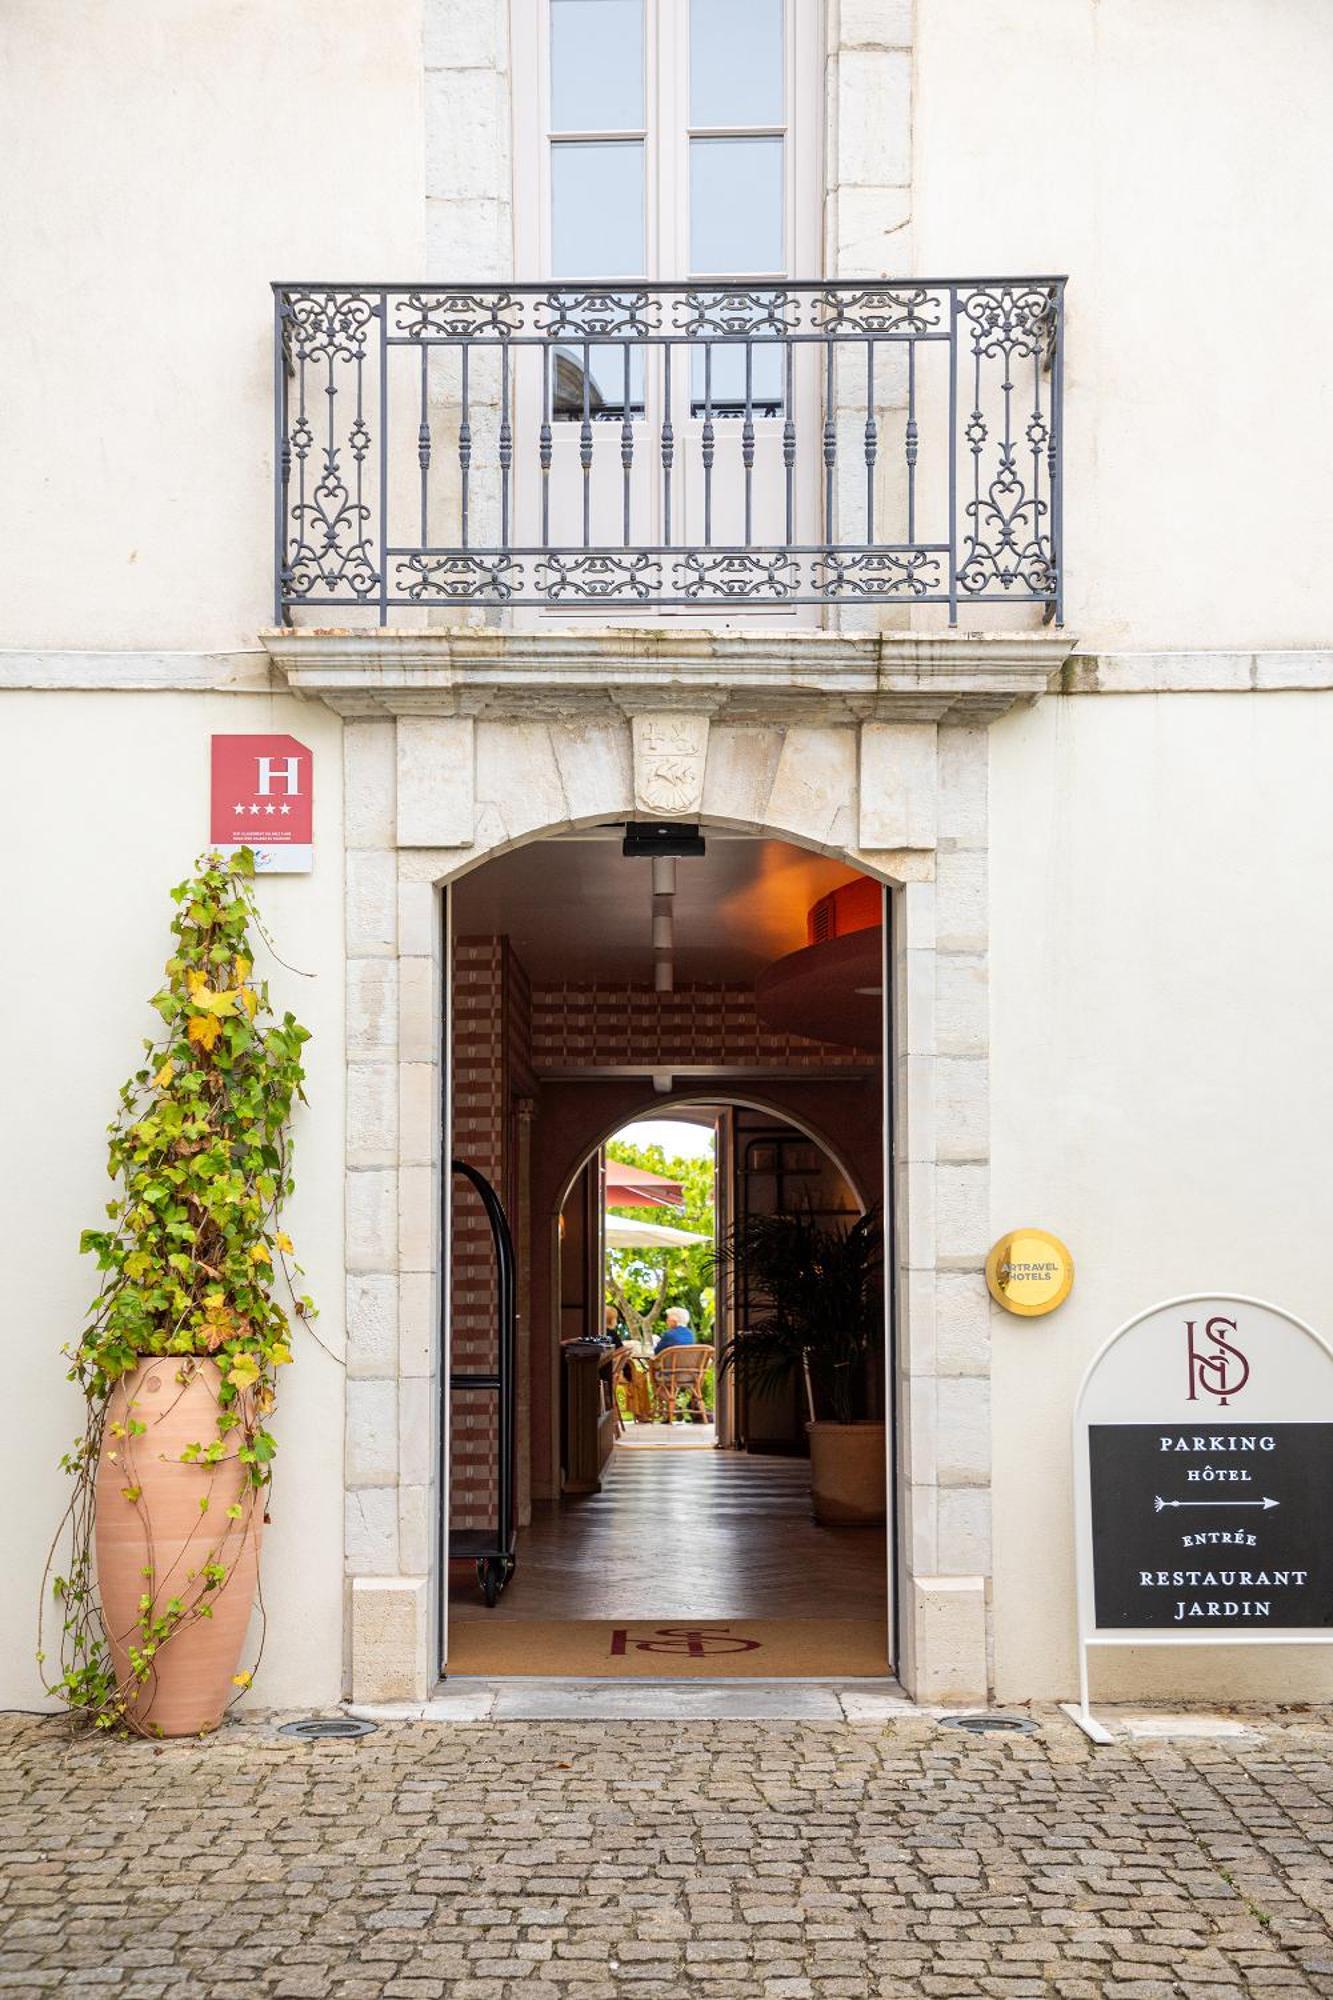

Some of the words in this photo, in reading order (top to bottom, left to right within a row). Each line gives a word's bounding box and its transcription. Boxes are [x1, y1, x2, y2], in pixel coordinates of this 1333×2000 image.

[253, 756, 304, 796] H
[1002, 1263, 1058, 1272] ARTRAVEL
[1009, 1272, 1052, 1281] HOTELS
[1159, 1436, 1277, 1452] PARKING
[1187, 1465, 1252, 1482] HÔTEL
[1182, 1529, 1257, 1548] ENTRÉE
[1139, 1571, 1308, 1587] RESTAURANT
[1174, 1601, 1272, 1620] JARDIN
